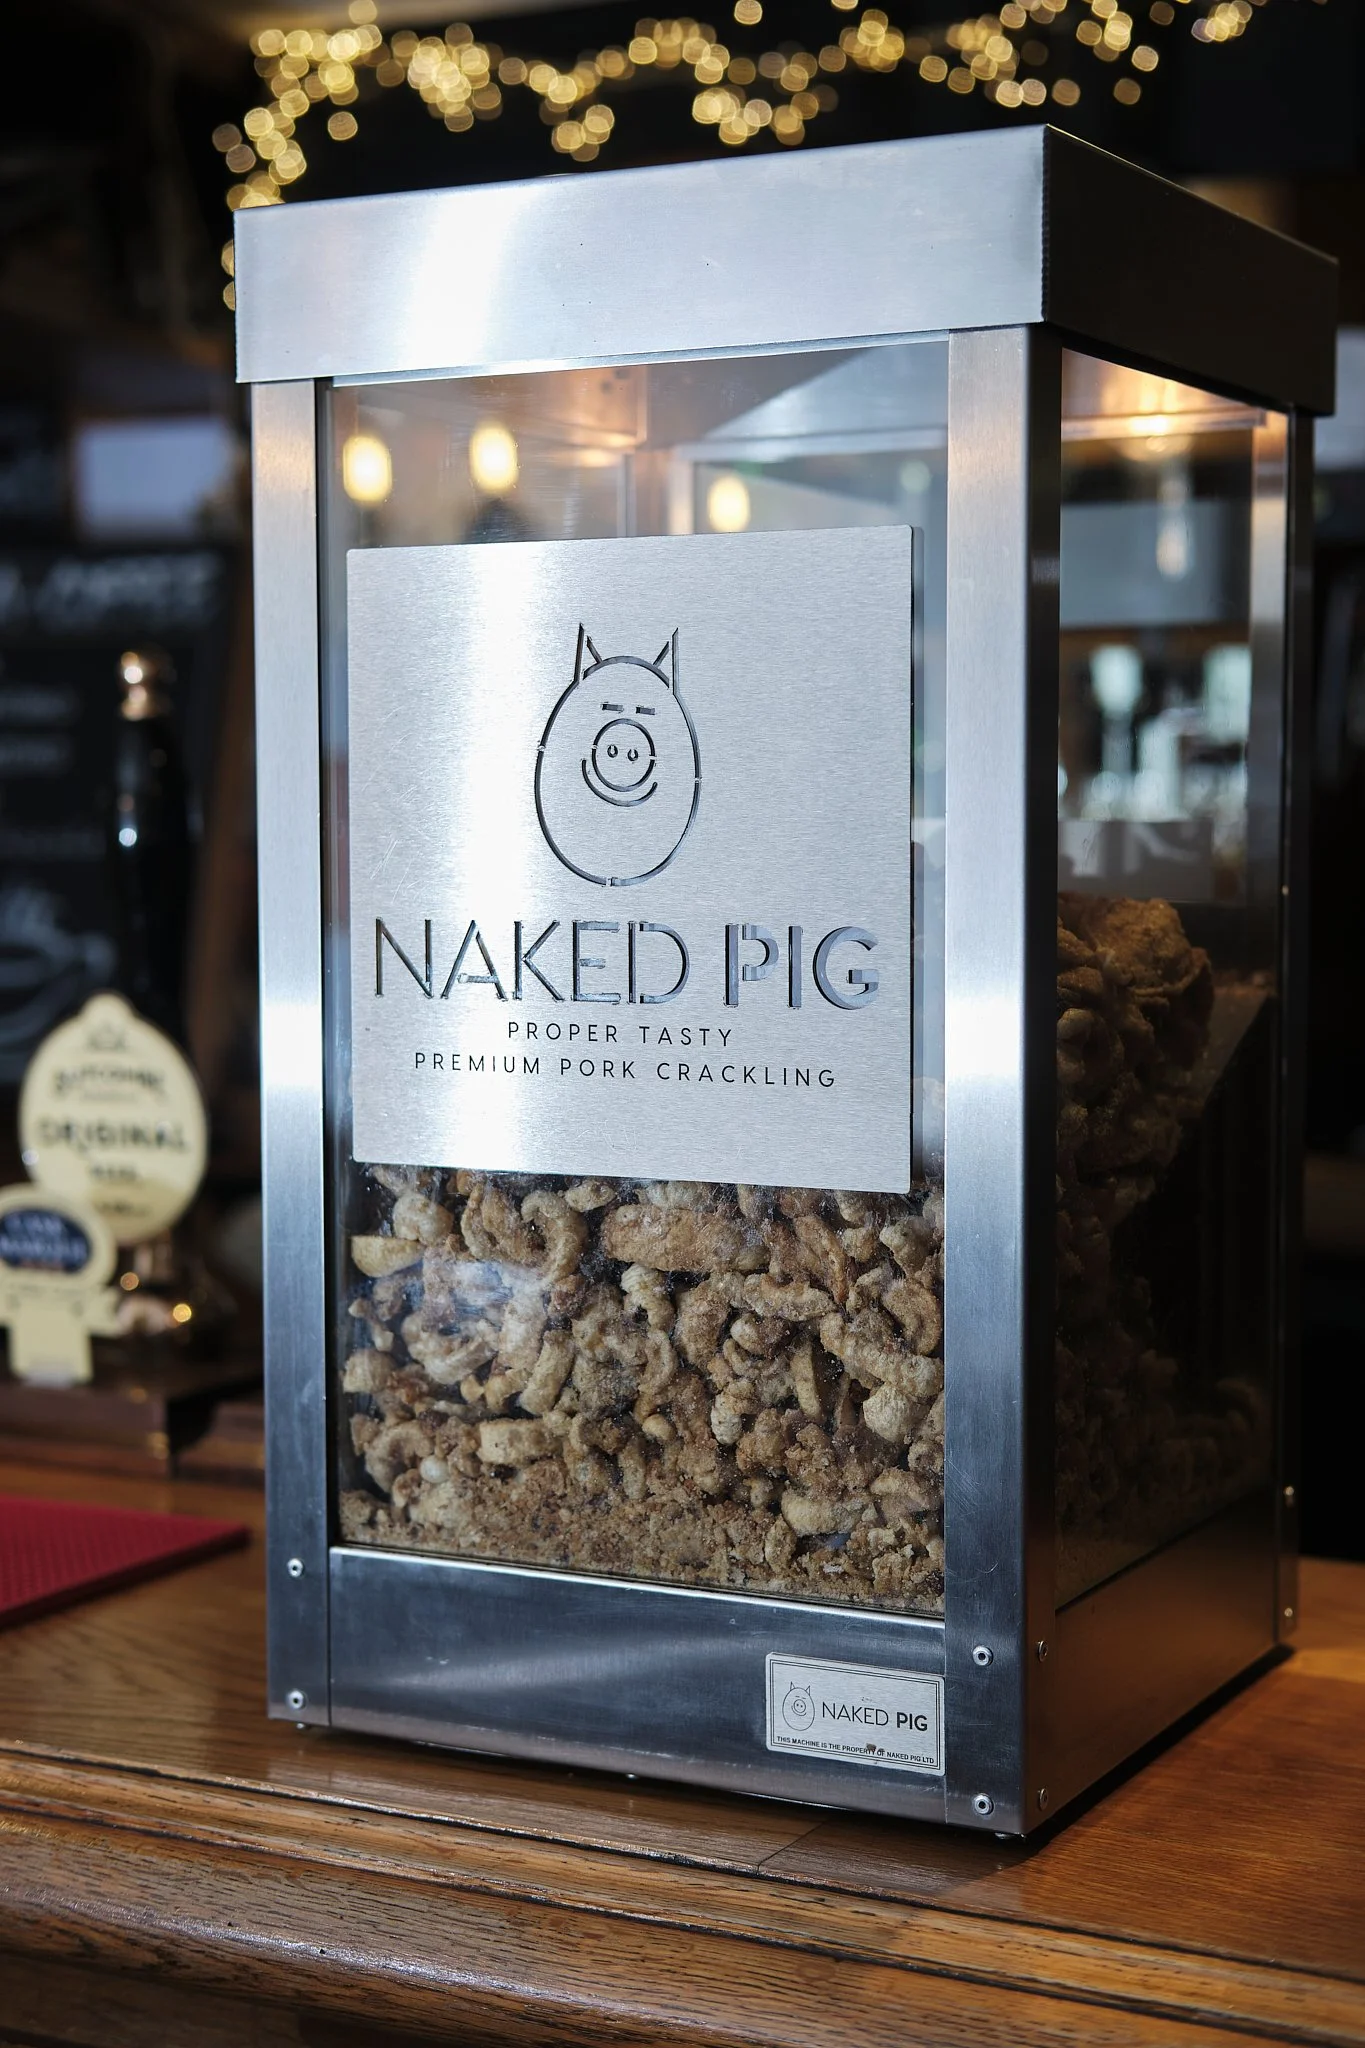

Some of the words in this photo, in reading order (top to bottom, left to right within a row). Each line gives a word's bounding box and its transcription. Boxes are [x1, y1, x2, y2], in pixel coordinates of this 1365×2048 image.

[374, 916, 691, 1005] NAKED
[723, 922, 880, 1011] PIG
[507, 1021, 618, 1043] PROPER
[638, 1025, 732, 1047] TASTY
[414, 1052, 540, 1075] PREMIUM
[560, 1058, 636, 1079] PORK
[656, 1062, 835, 1088] CRACKLING
[822, 1701, 889, 1726] NAKED
[896, 1711, 928, 1732] PIG
[776, 1735, 791, 1744] THIS
[791, 1738, 820, 1748] MACHINE
[829, 1743, 841, 1751] THE
[842, 1745, 876, 1756] PROPERTY
[877, 1748, 886, 1757] OF
[886, 1751, 909, 1760] NAKED
[910, 1754, 921, 1762] PIG
[922, 1756, 935, 1764] LTD
